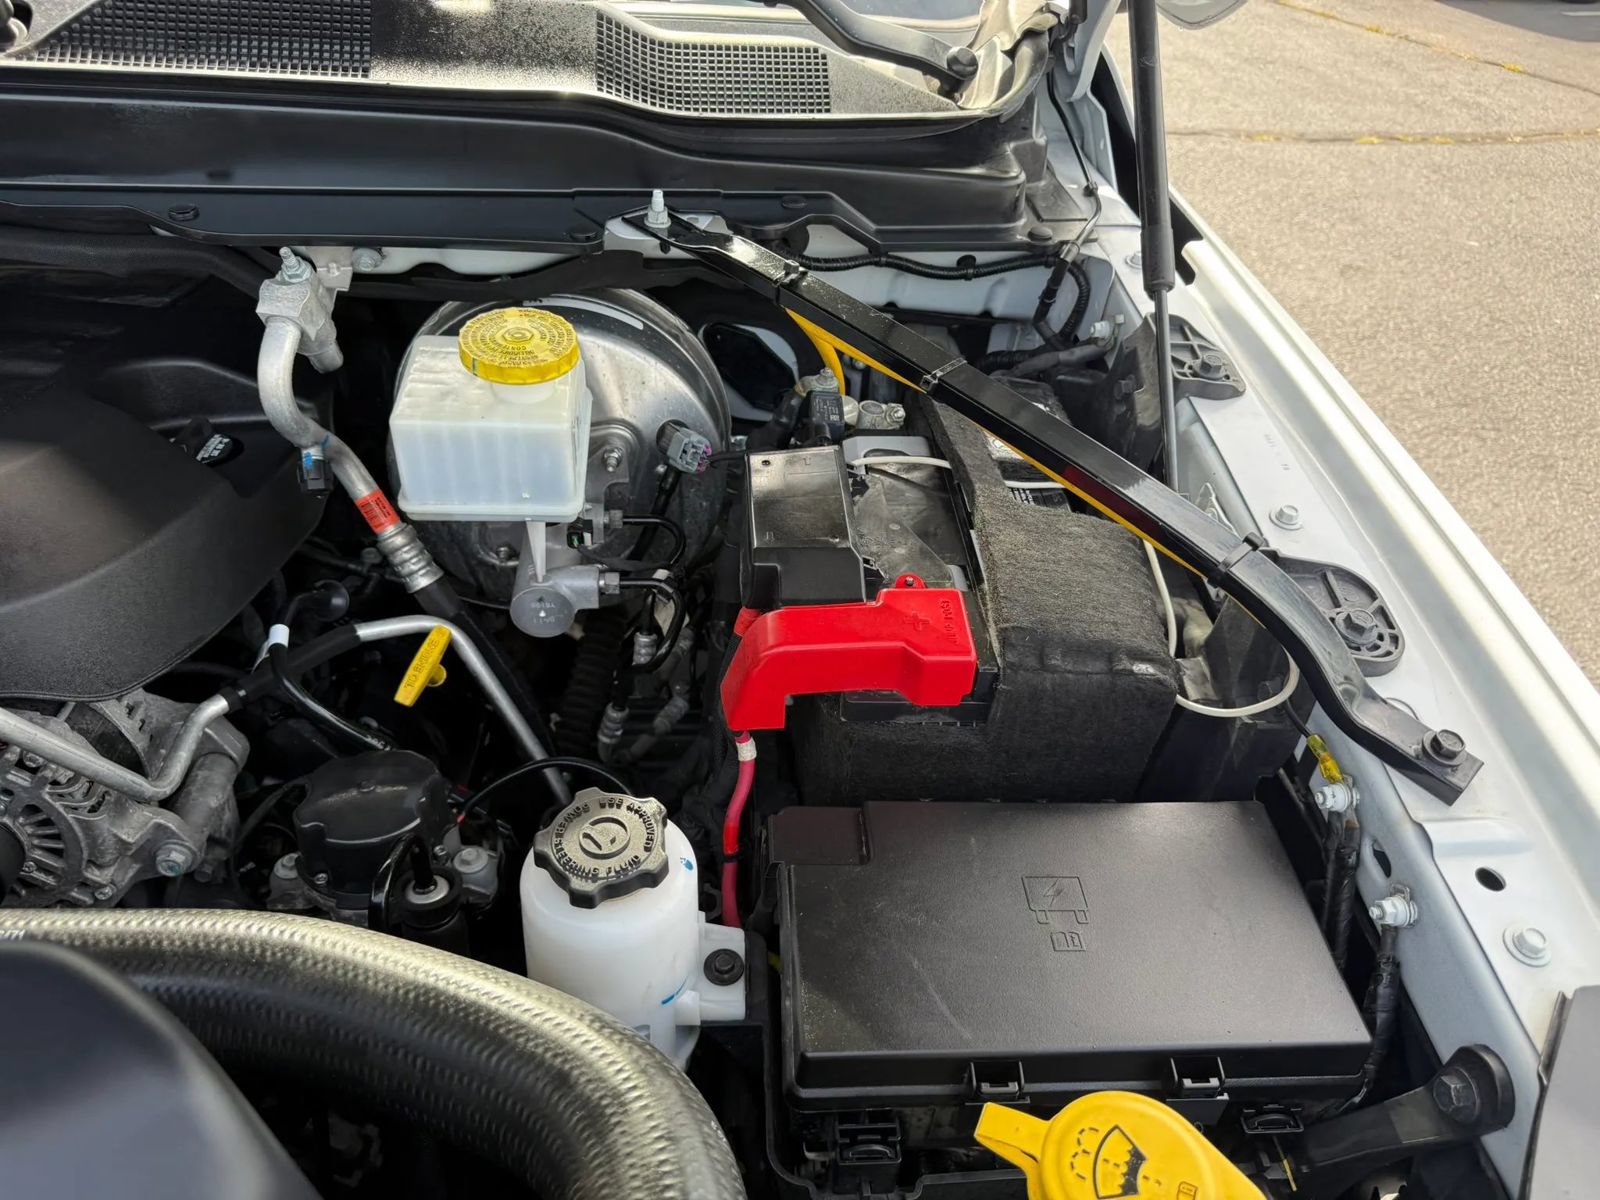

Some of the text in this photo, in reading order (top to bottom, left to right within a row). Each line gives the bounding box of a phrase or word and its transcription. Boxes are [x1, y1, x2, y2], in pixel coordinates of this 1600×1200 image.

[553, 802, 642, 879] POWER STEERING FLUID
[598, 797, 656, 852] USE APPROVED
